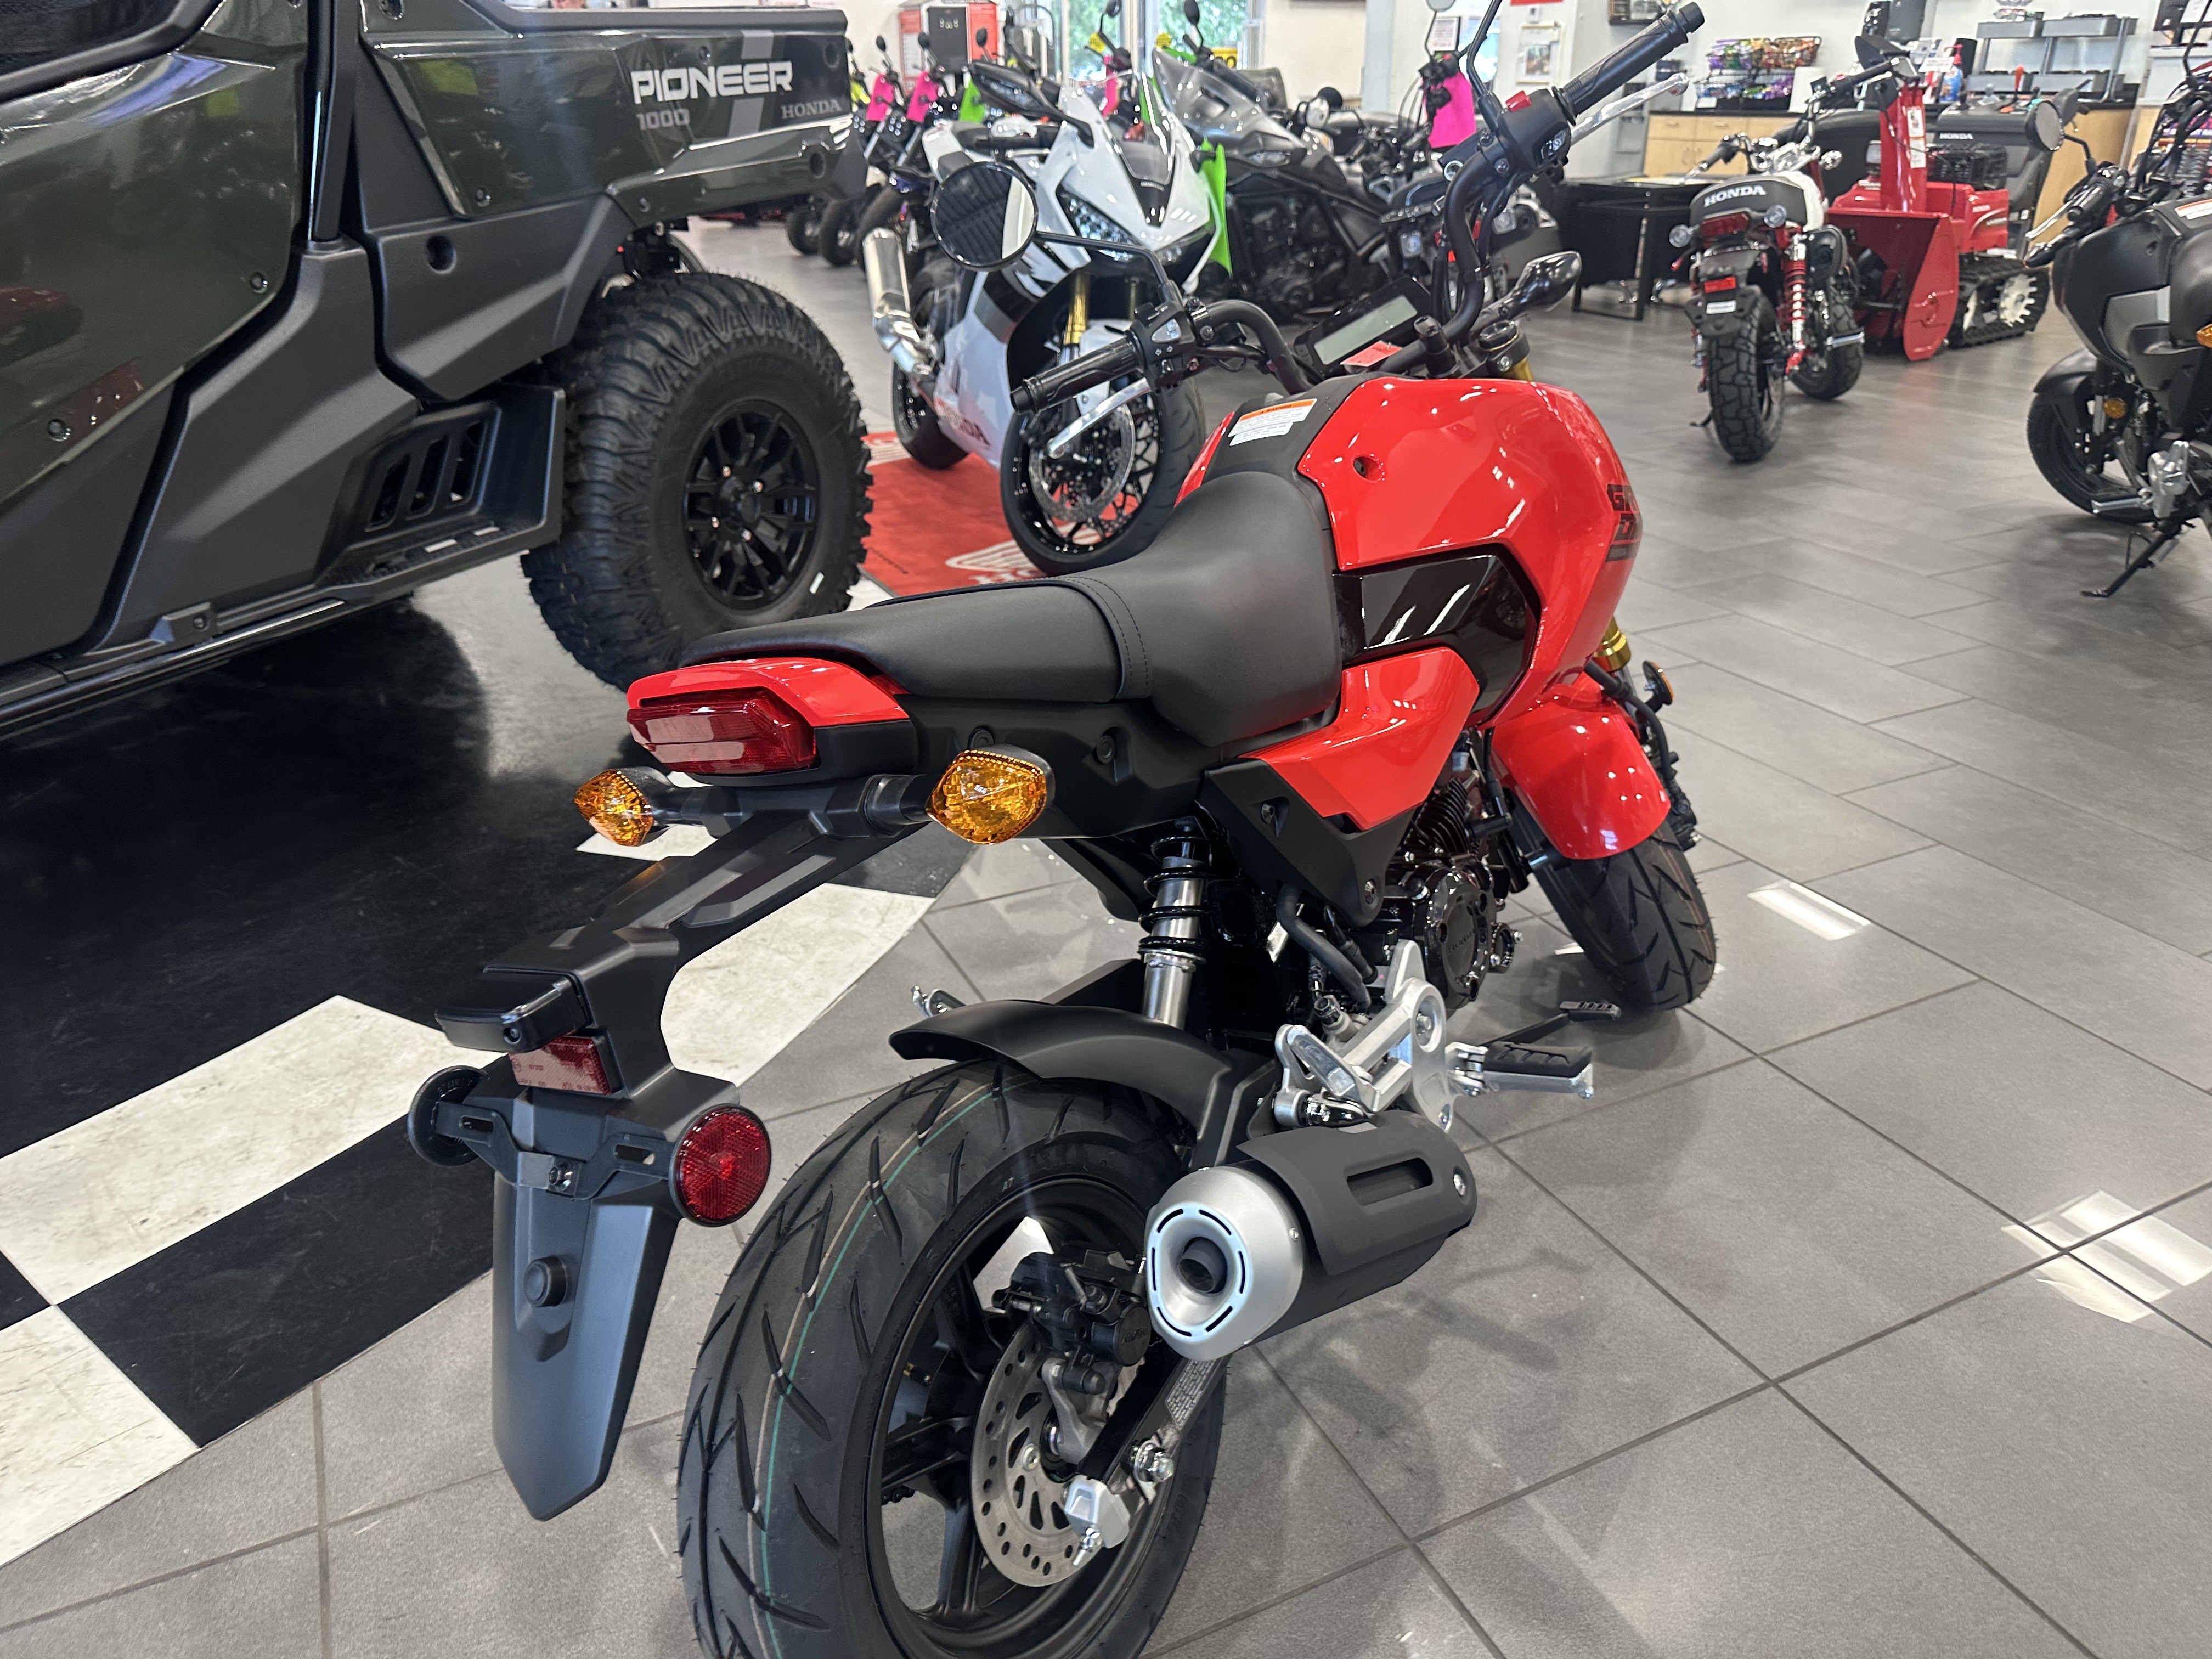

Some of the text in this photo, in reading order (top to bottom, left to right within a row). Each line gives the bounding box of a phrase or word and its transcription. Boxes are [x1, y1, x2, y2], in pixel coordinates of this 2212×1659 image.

[630, 60, 793, 104] PIONEER
[635, 109, 690, 131] 1000
[781, 99, 842, 119] HONDA
[1703, 185, 1767, 207] HONDA
